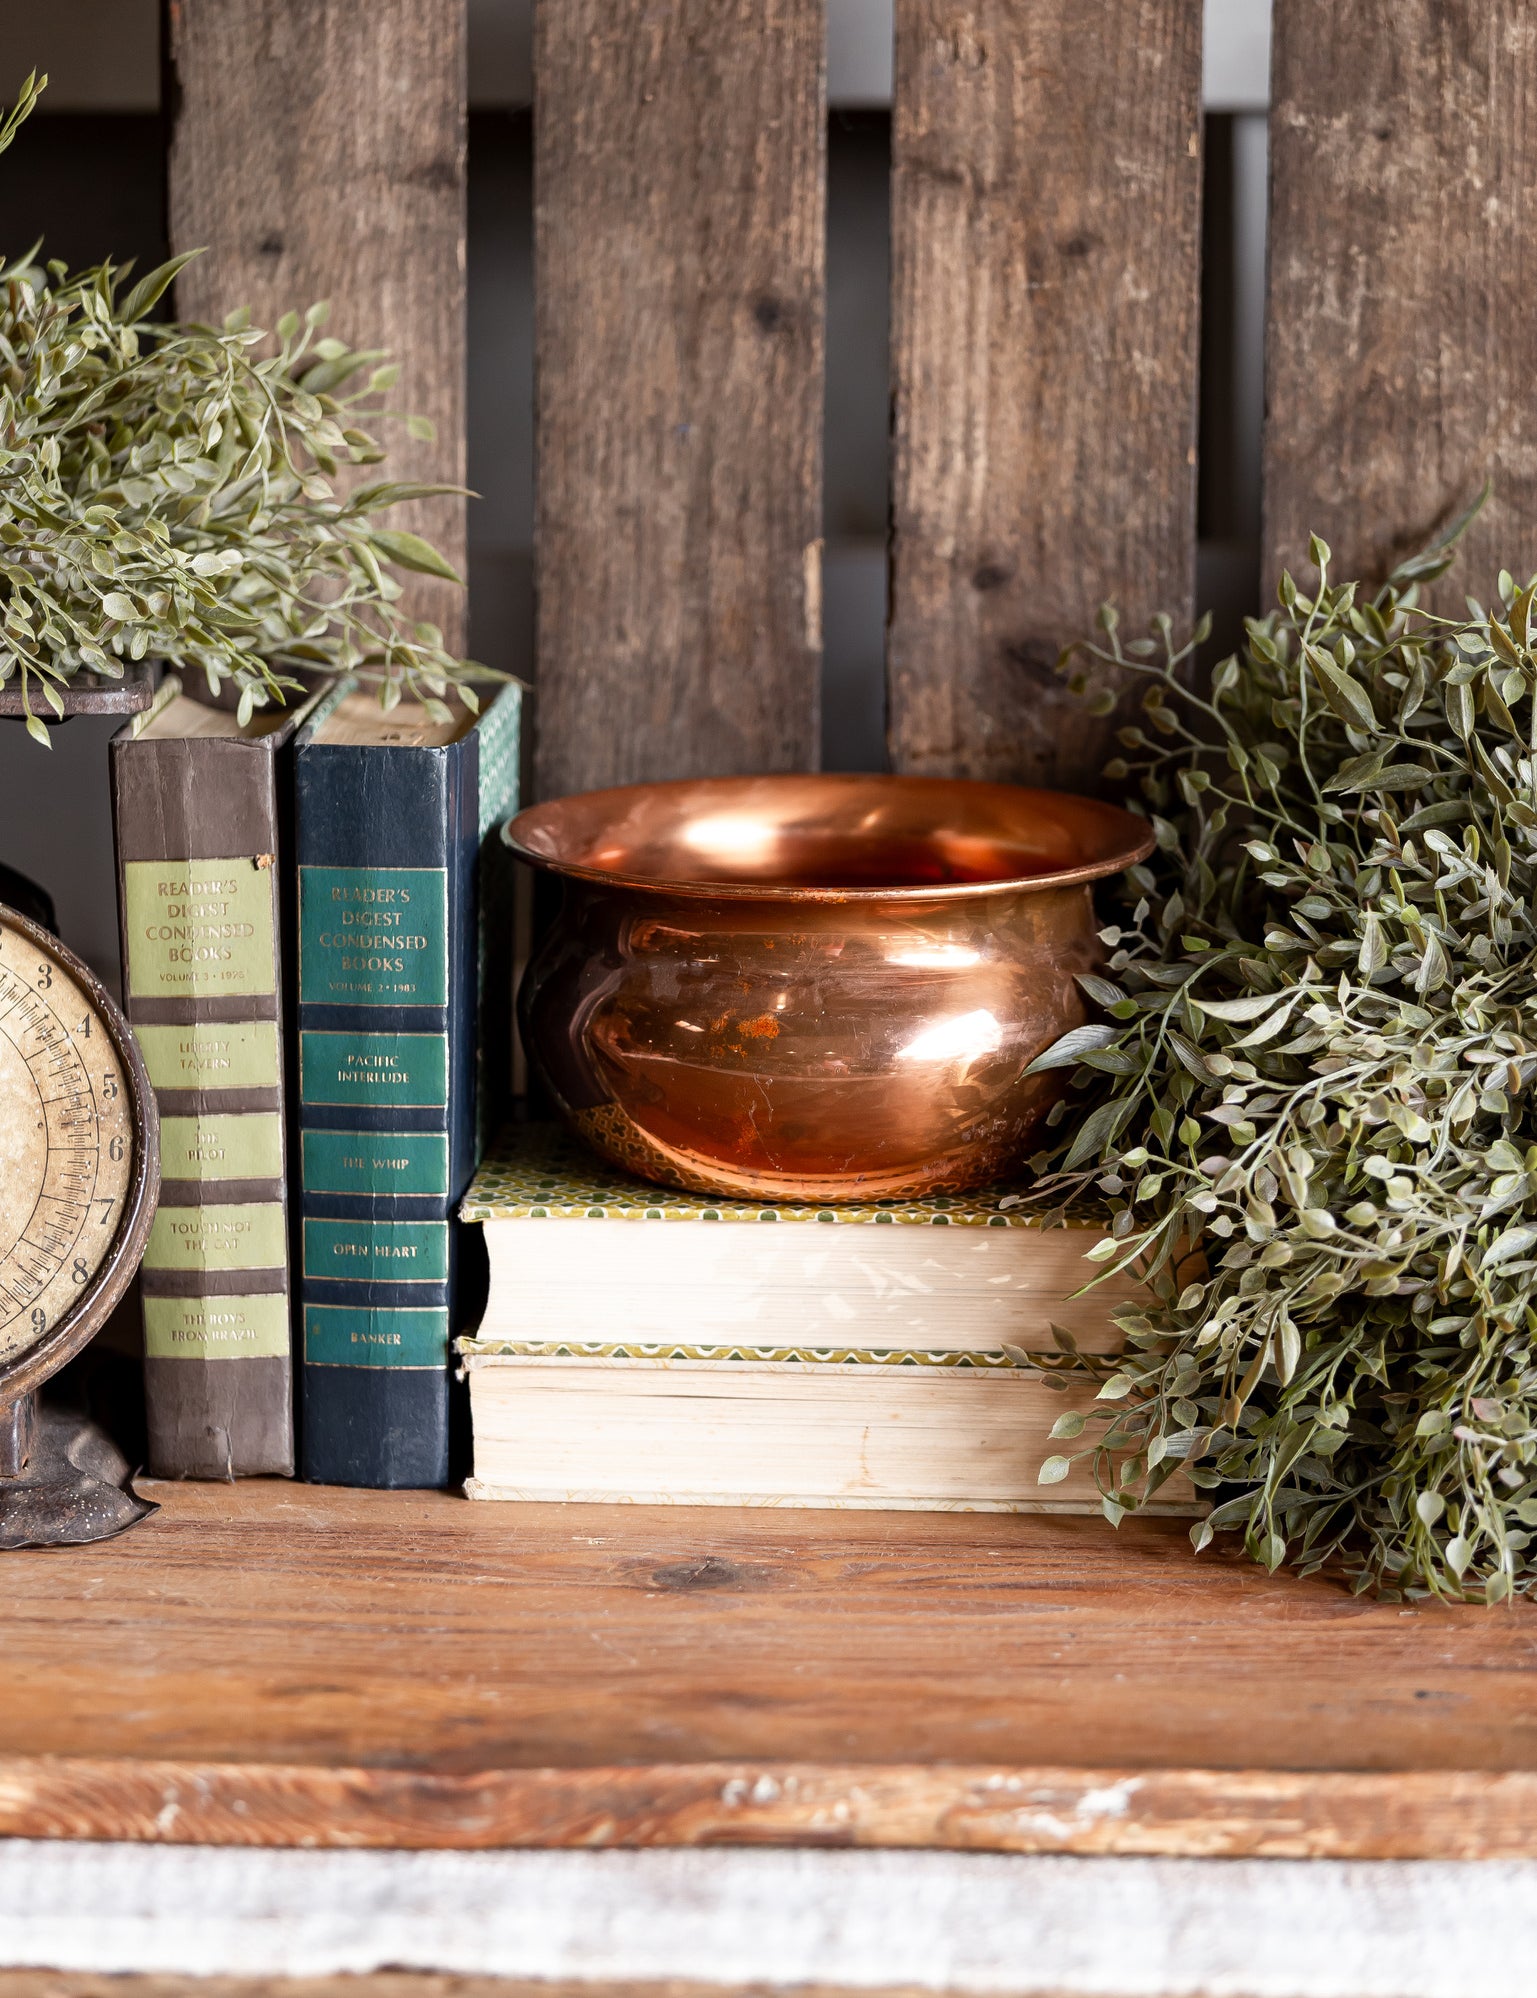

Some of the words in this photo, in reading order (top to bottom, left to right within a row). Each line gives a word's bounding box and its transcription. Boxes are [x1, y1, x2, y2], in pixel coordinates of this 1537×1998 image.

[158, 880, 238, 896] READER'S
[332, 887, 410, 903] READER'S
[167, 902, 229, 918] DIGEST
[342, 911, 403, 926] DIGEST
[145, 923, 255, 940] CONDENSED
[319, 932, 428, 950] CONDENSED
[168, 945, 232, 962] BOOKS
[341, 956, 404, 972] BOOKS
[37, 963, 53, 990] 3
[160, 972, 199, 982] VOLUME
[329, 982, 373, 993] VOLUME
[378, 984, 384, 993] 2
[393, 984, 416, 993] 1983
[77, 1013, 93, 1039] 4
[179, 1041, 230, 1053] LIBERTY
[180, 1058, 231, 1070] TAVERN
[348, 1055, 399, 1068] PACIFIC
[338, 1070, 410, 1084] INTERLUDE
[103, 1073, 118, 1100] 5
[109, 1135, 124, 1162] 6
[187, 1148, 225, 1161] PILOT
[343, 1157, 364, 1169] THE
[372, 1158, 410, 1170] WHIP
[93, 1198, 116, 1225] 7
[170, 1222, 219, 1235] TOUCH
[223, 1221, 251, 1233] NOT
[185, 1239, 208, 1251] THE
[333, 1243, 368, 1256] OPEN
[375, 1245, 418, 1258] HEART
[71, 1257, 89, 1285] 8
[31, 1307, 47, 1335] 9
[184, 1313, 206, 1326] THE
[209, 1312, 246, 1325] BOYS
[171, 1330, 209, 1343] FROM
[212, 1328, 259, 1341] BRAZIL
[350, 1331, 402, 1346] BANKER
